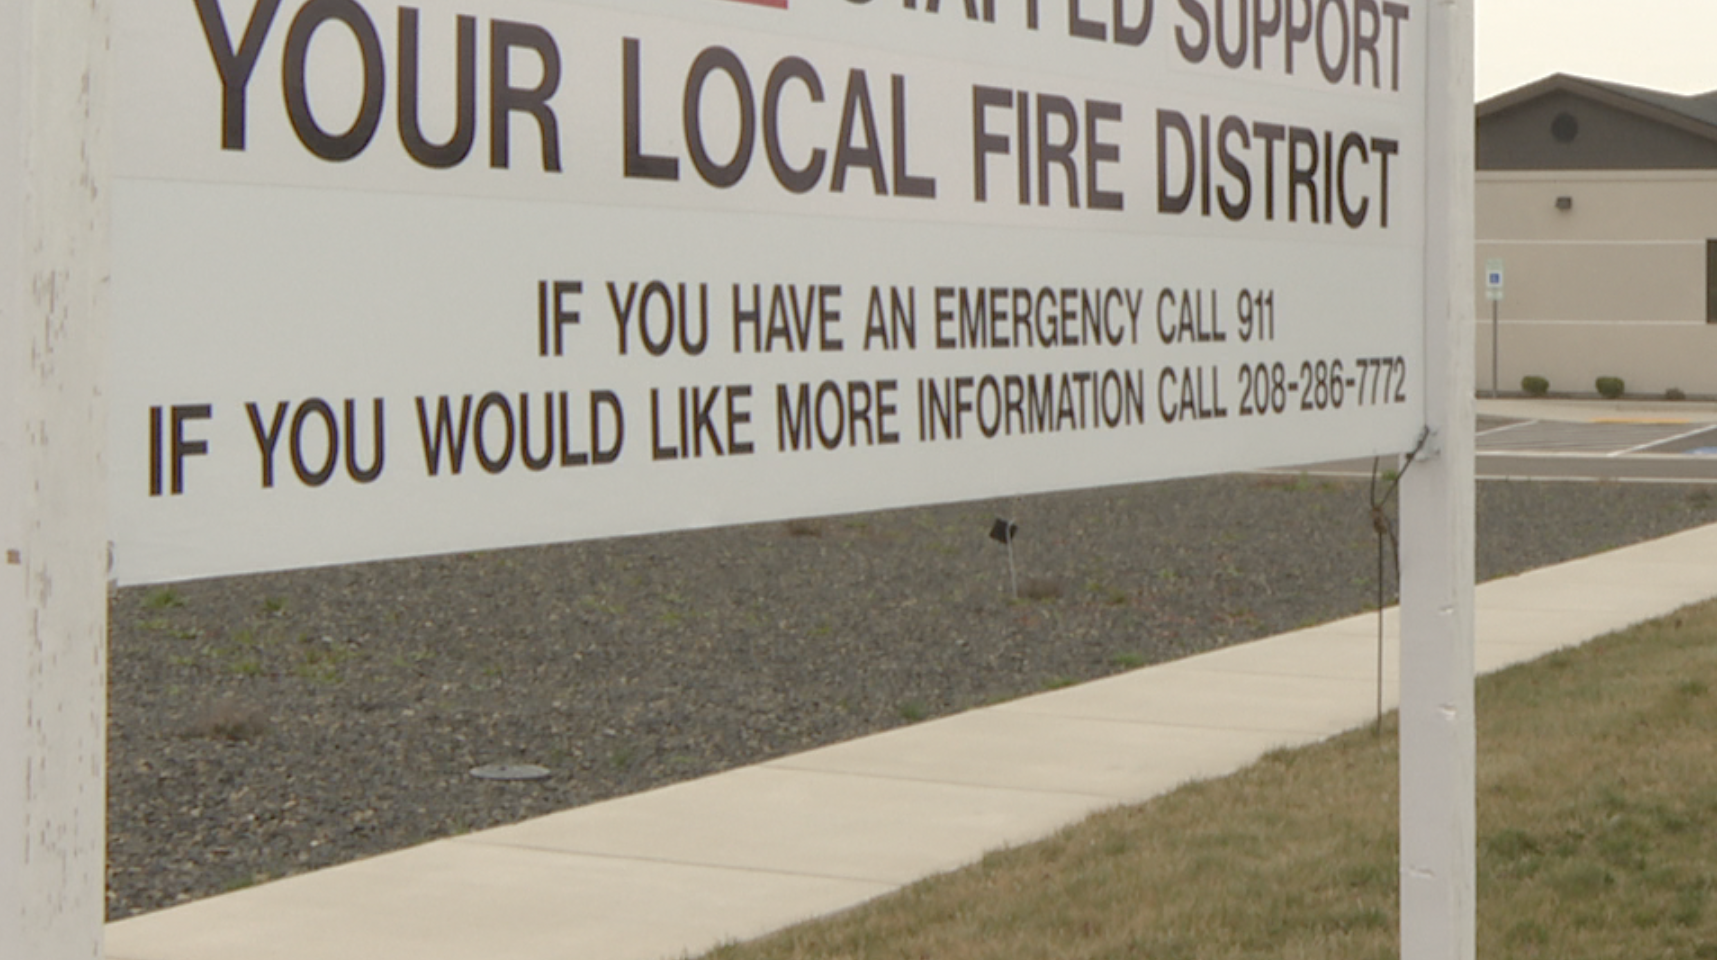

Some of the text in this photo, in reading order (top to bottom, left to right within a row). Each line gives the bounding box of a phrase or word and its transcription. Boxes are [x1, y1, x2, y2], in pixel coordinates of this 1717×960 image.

[622, 36, 937, 200] LOCAL
[972, 84, 1125, 212] FIRE
[1155, 108, 1399, 230] DISTRICT
[537, 279, 1276, 358] IF YOU HAVE AN EMERGENCY CALL 911
[147, 355, 1406, 498] IF YOU WOULD LIKE MORE INFORMATION CALL 208-286-7772
